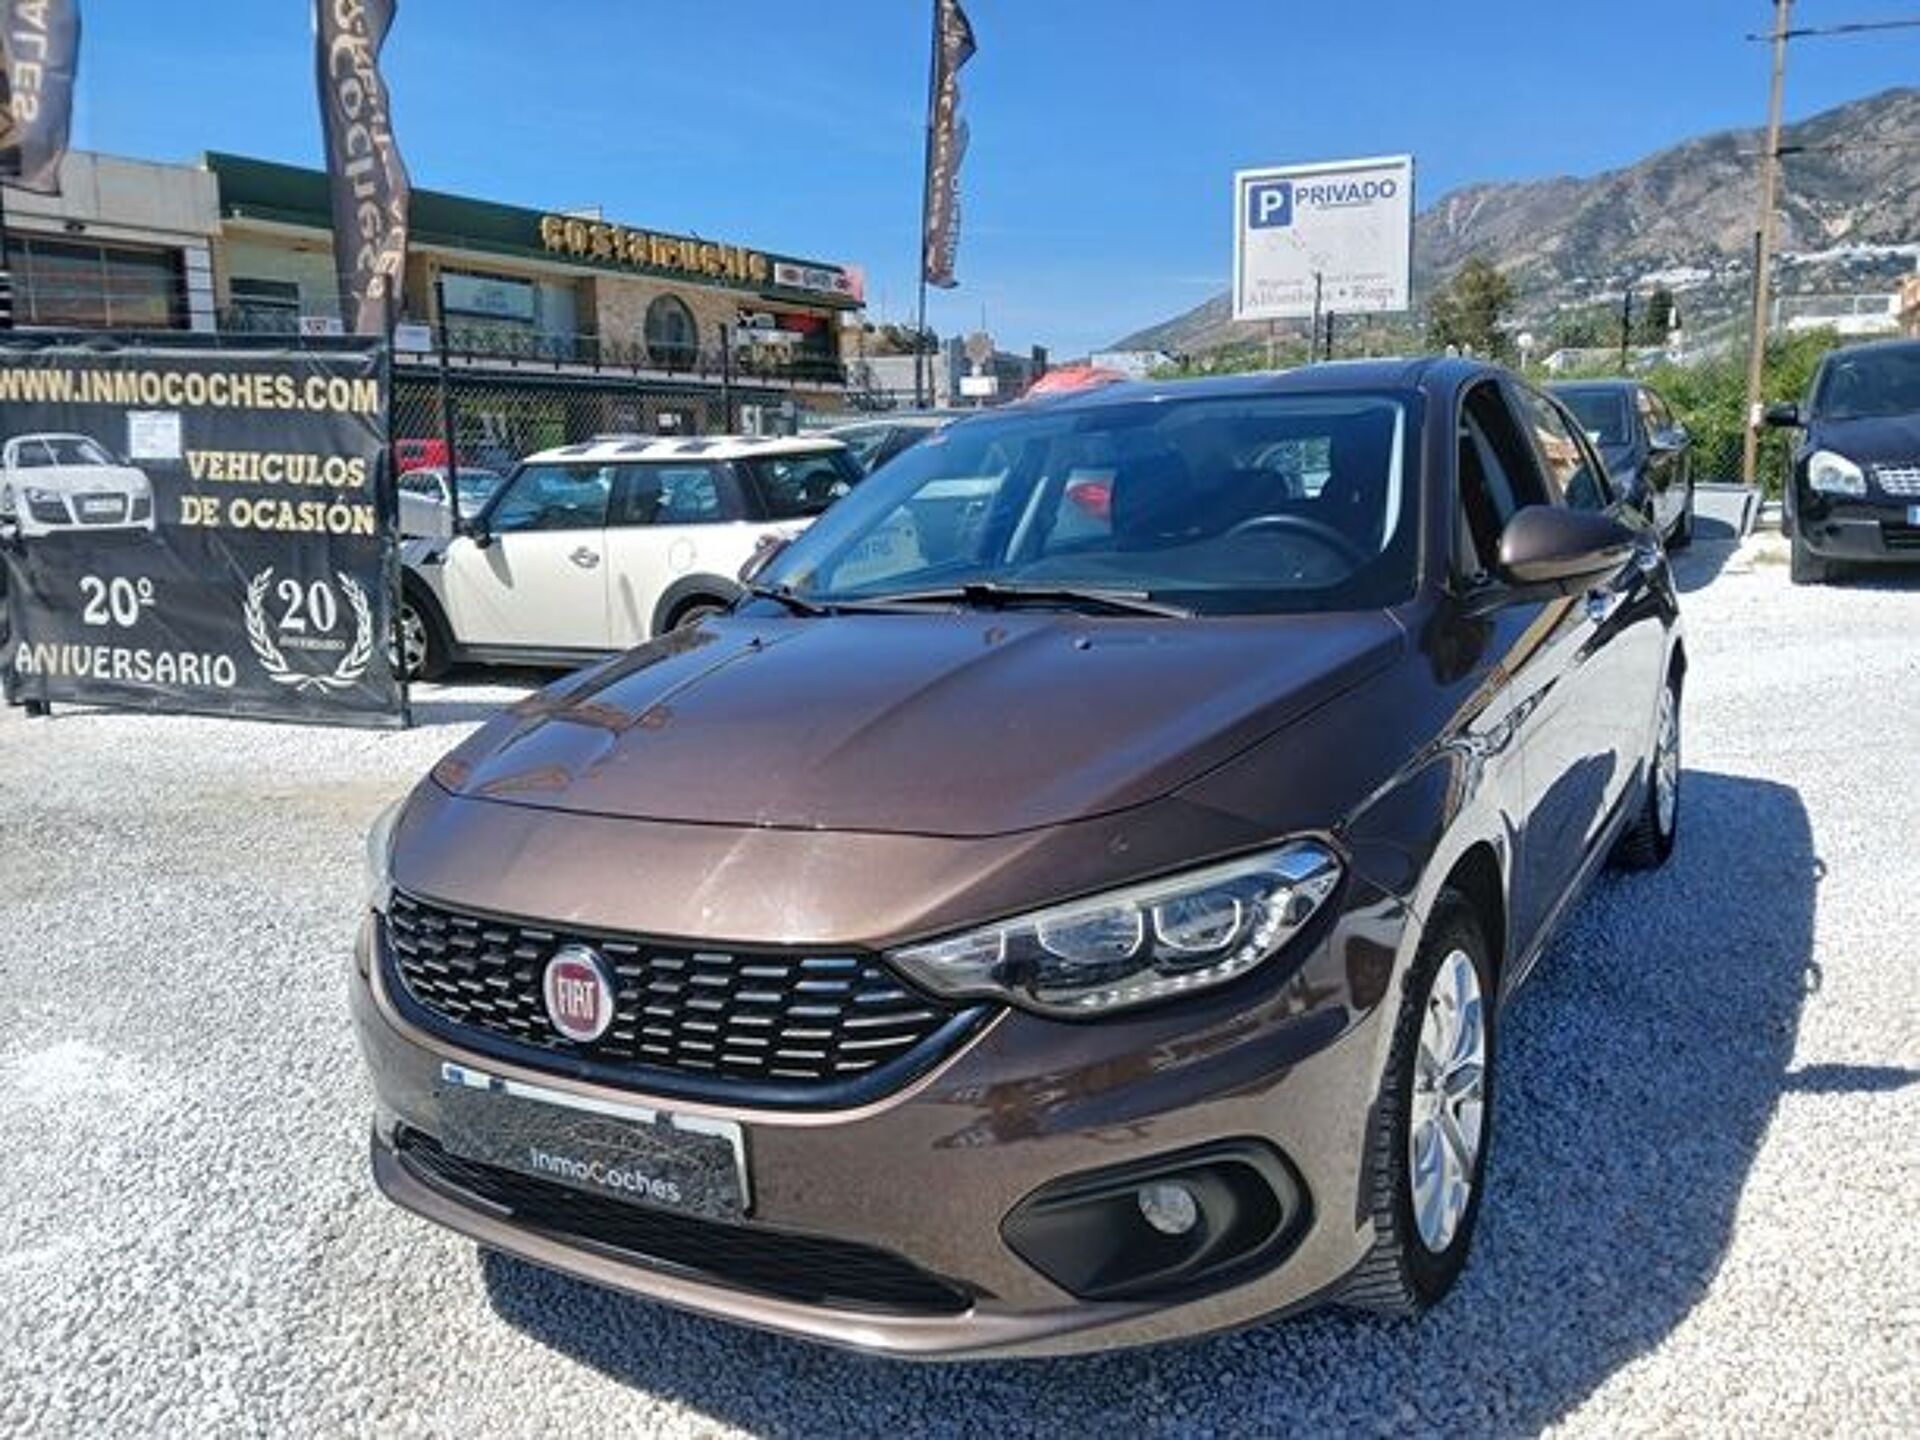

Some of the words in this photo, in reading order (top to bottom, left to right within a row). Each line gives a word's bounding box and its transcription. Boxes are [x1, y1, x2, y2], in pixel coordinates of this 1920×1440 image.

[1260, 190, 1284, 222] P
[1295, 179, 1397, 207] PRIVADO
[0, 368, 378, 414] WWW.INMOCOCHES.COM
[185, 450, 366, 488] VEHICULOS
[181, 495, 220, 527] DE
[229, 495, 376, 535] OCASIÓN
[278, 578, 337, 632] 20
[14, 641, 237, 687] ANIVERSARIO
[556, 977, 595, 1021] FIAT
